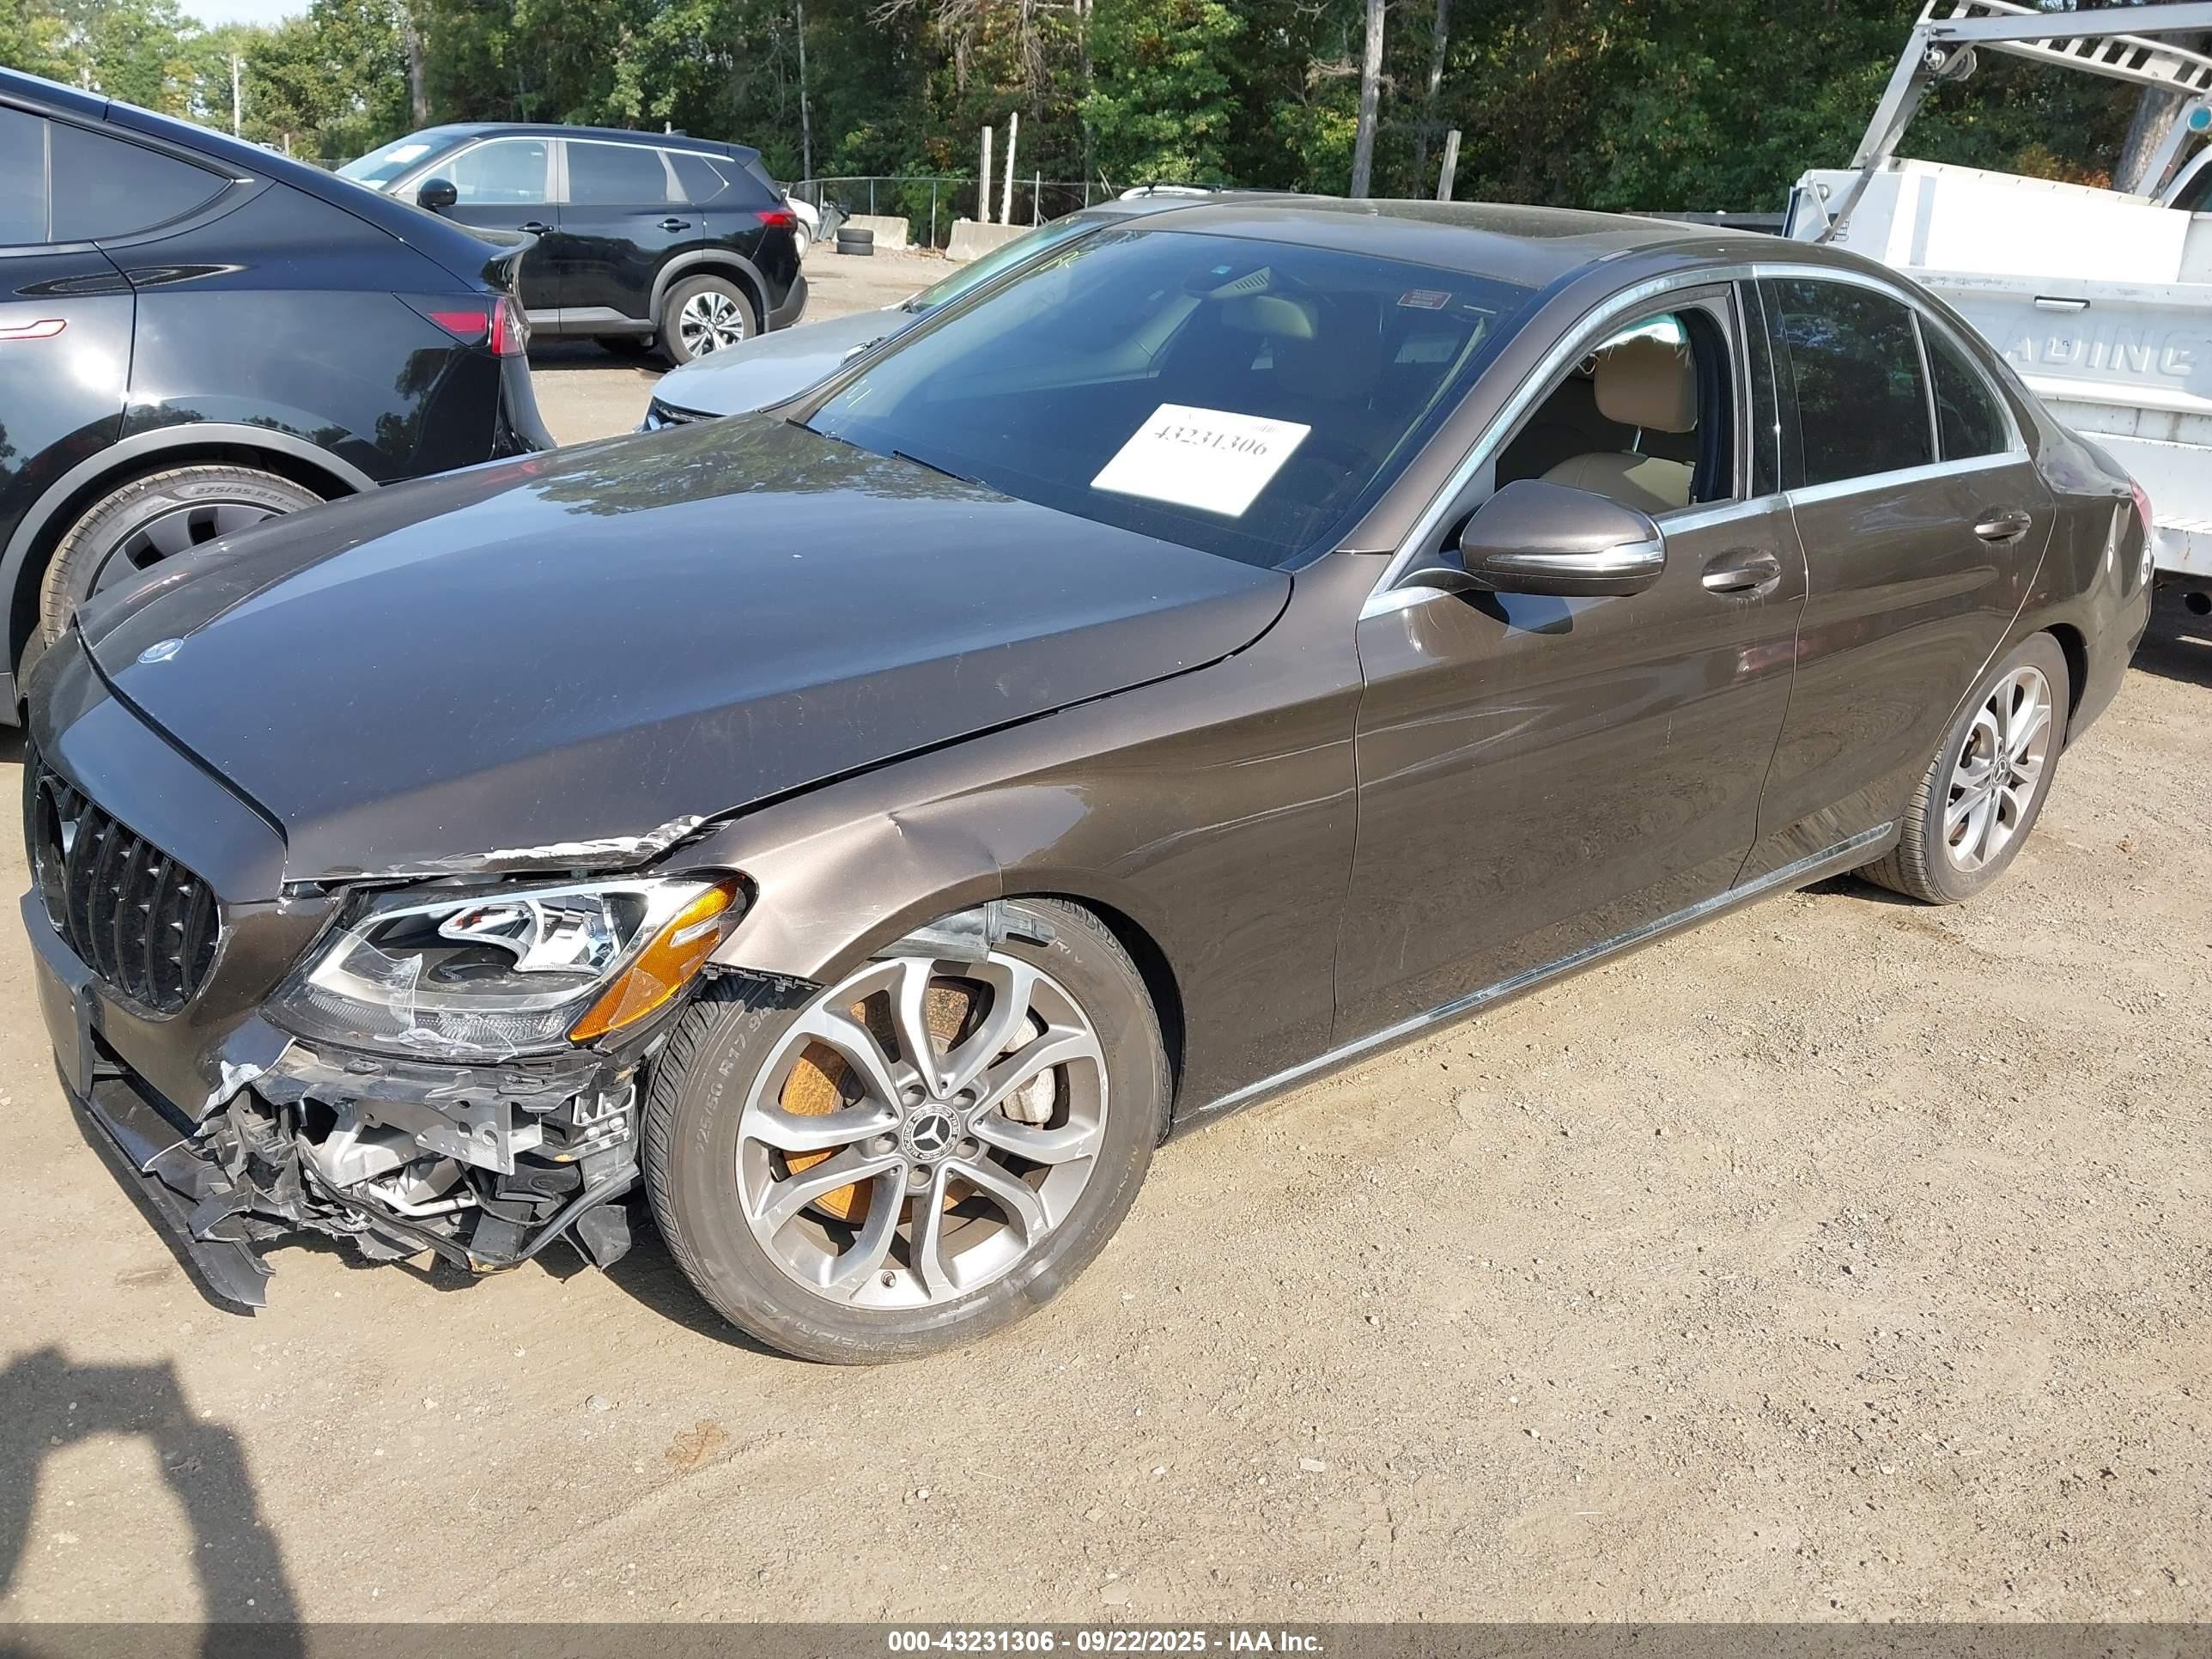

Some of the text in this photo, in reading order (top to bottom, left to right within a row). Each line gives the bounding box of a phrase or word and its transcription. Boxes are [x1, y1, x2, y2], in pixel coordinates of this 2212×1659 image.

[1972, 314, 2202, 378] ADING
[1154, 426, 1268, 455] 43231306
[195, 485, 252, 495] 275/35
[695, 1082, 724, 1155] 225/50
[718, 1033, 747, 1077] R17
